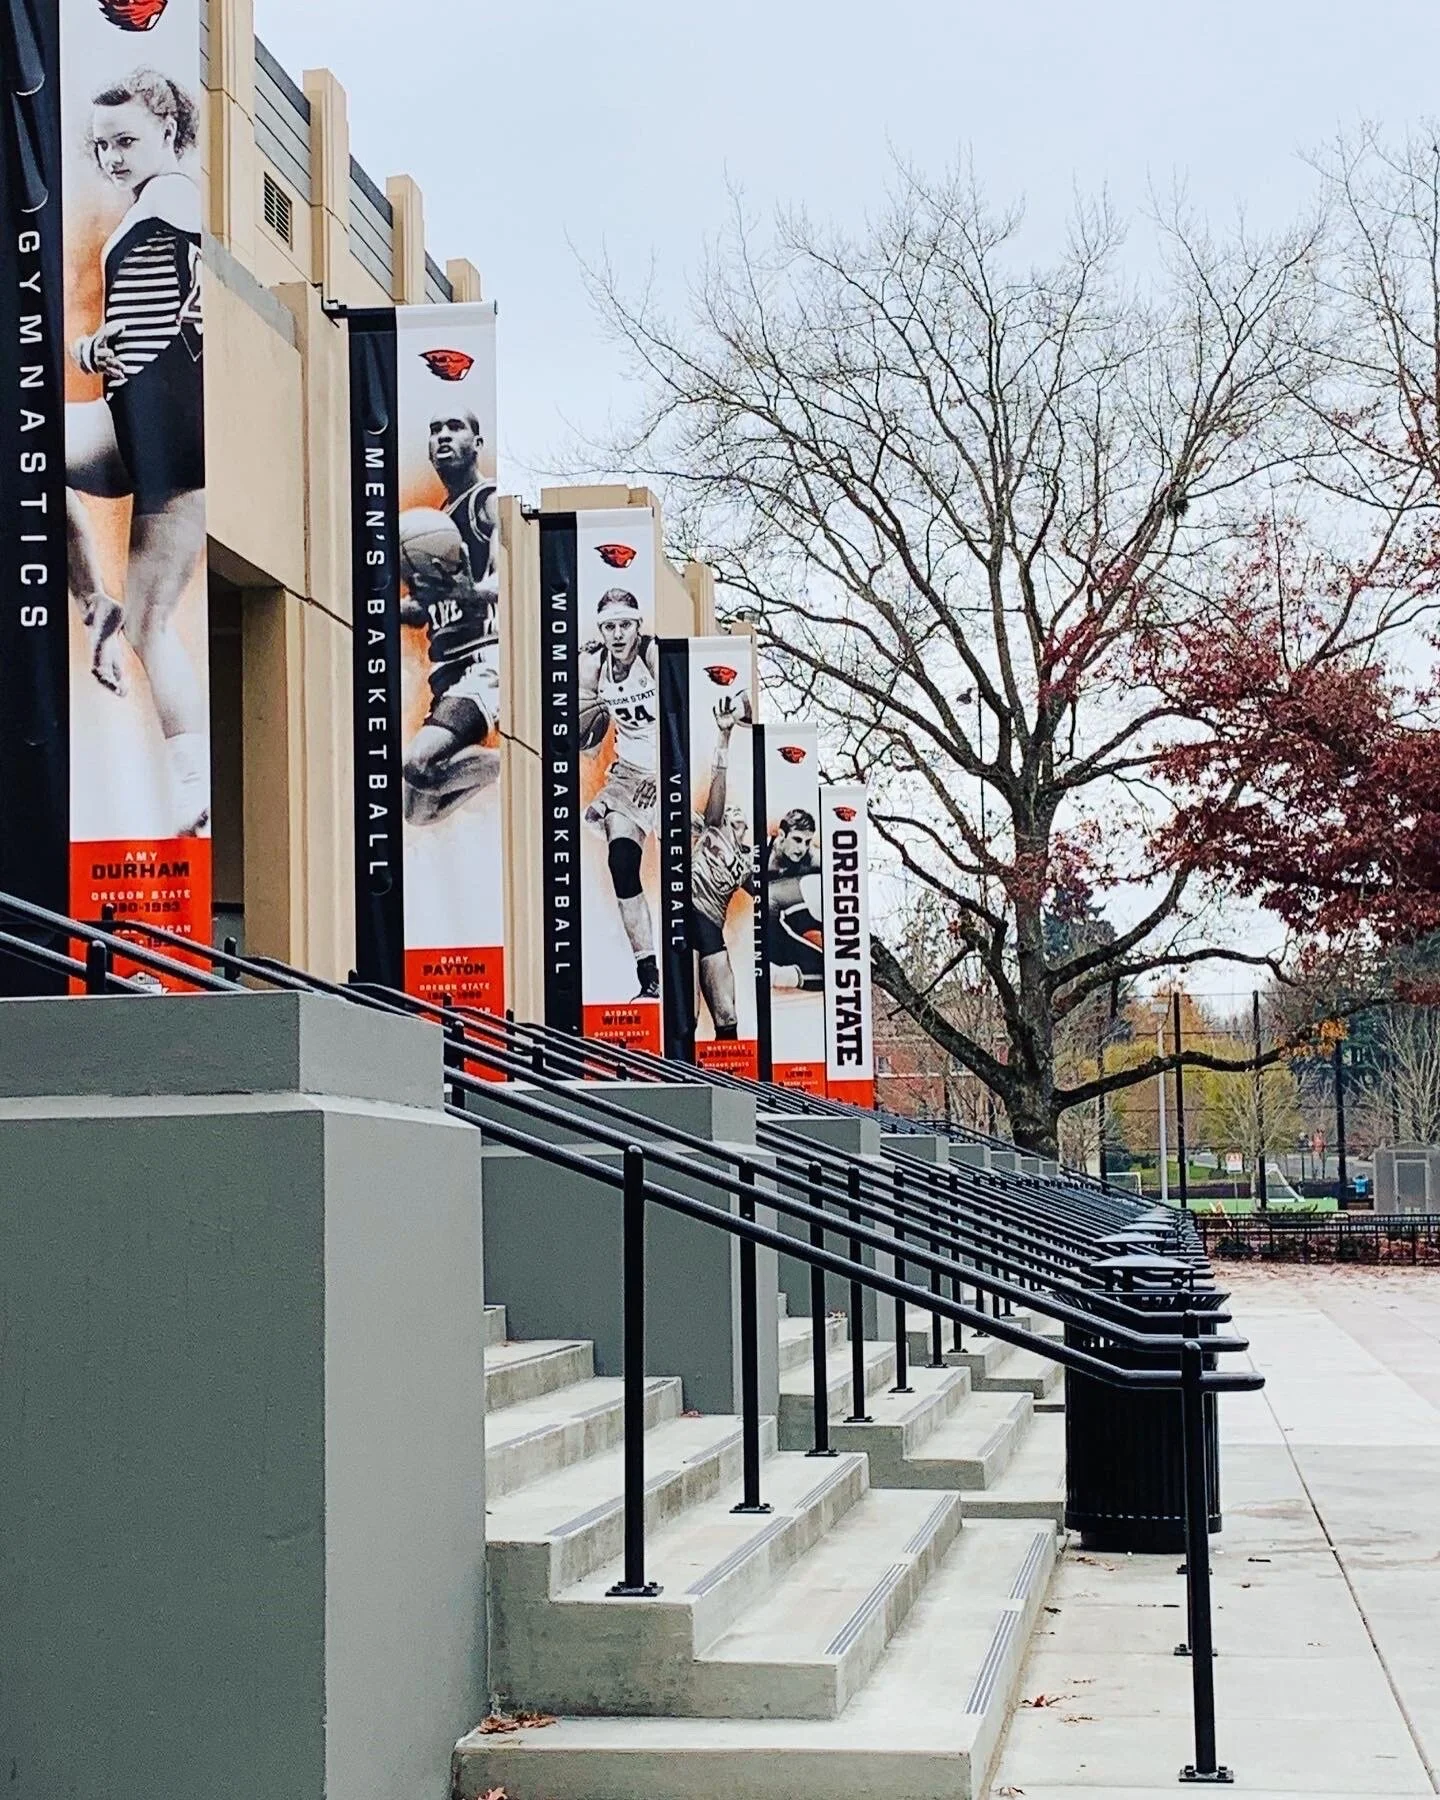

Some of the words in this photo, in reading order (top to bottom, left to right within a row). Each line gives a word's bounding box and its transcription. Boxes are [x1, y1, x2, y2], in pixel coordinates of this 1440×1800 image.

[18, 230, 48, 627] GYMNASTICS
[365, 447, 385, 565] MEN'S
[551, 592, 569, 736] WOMEN'S
[367, 599, 389, 875] BASKETBALL
[91, 861, 190, 880] DURHAM
[91, 890, 144, 901] OREGON
[151, 889, 191, 900] STATE
[125, 851, 157, 861] AMY
[553, 761, 571, 974] BASKETBALL
[669, 773, 685, 945] VOLLEYBALL
[832, 829, 860, 960] OREGON
[422, 963, 486, 976] PAYTON
[440, 956, 469, 964] GARY
[461, 982, 490, 990] STATE
[835, 969, 863, 1067] STATE
